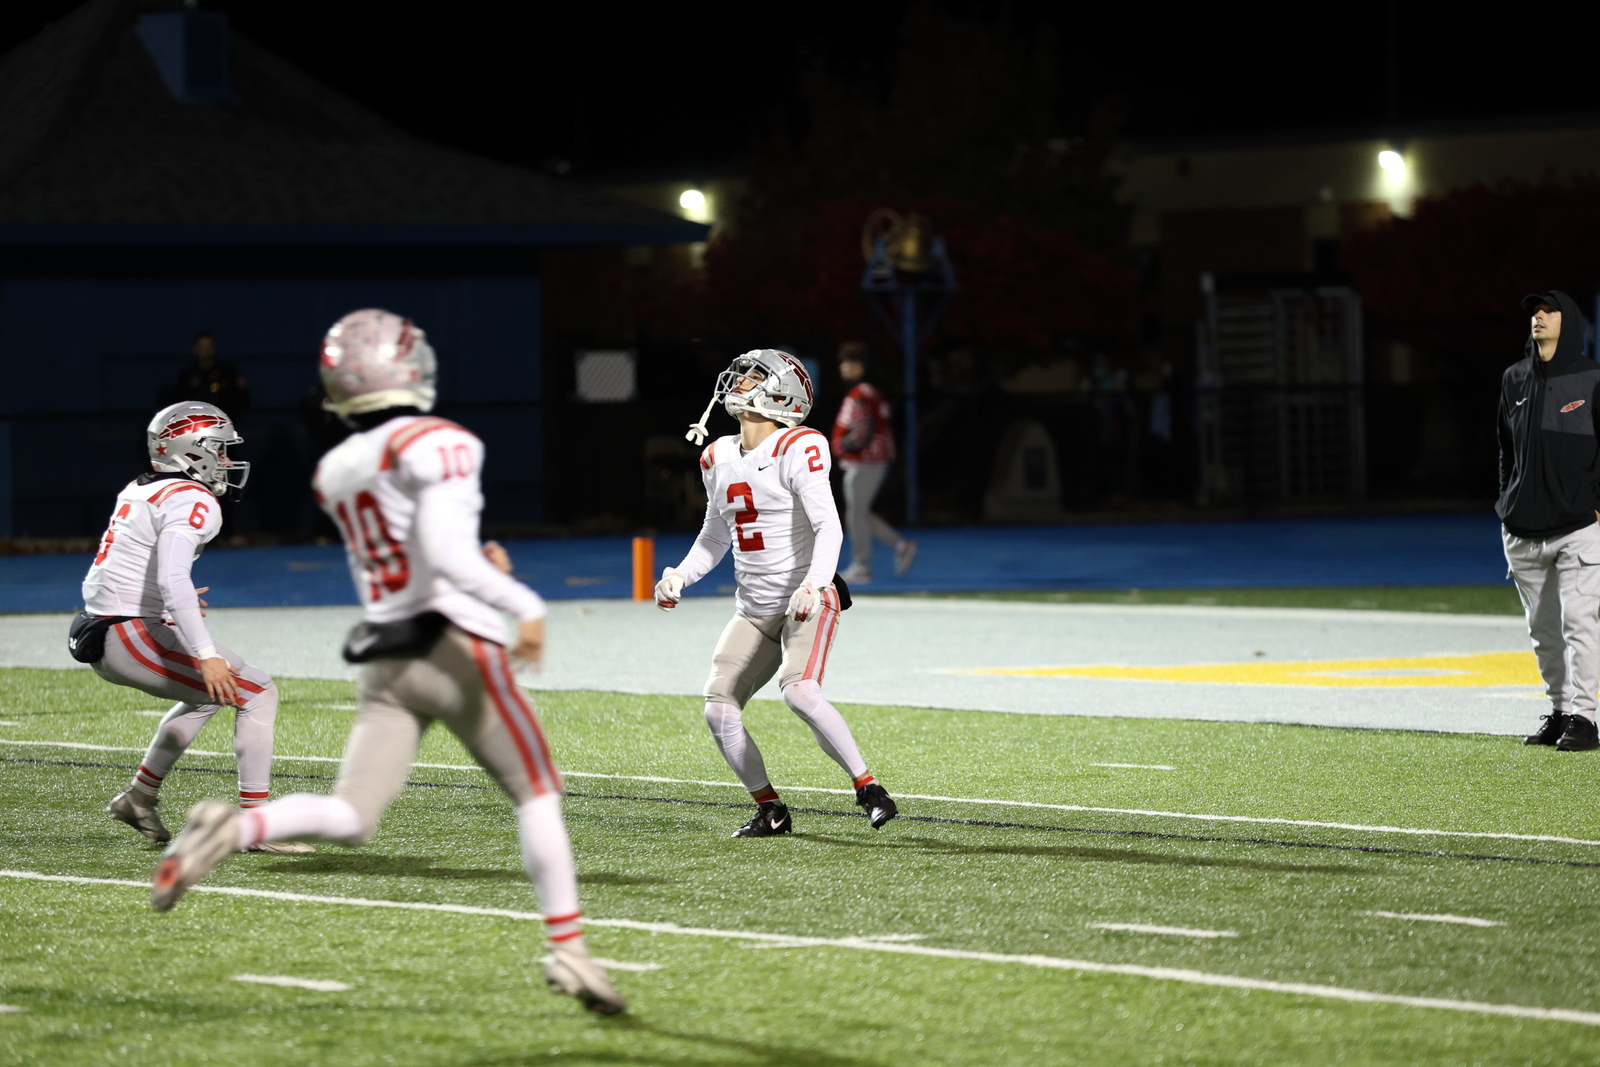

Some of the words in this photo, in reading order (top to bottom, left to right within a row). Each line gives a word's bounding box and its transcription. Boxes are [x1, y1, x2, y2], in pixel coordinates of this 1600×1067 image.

[437, 446, 474, 480] 10
[804, 445, 824, 472] 2
[189, 502, 209, 529] 6
[726, 482, 765, 552] 2
[335, 490, 410, 601] 10
